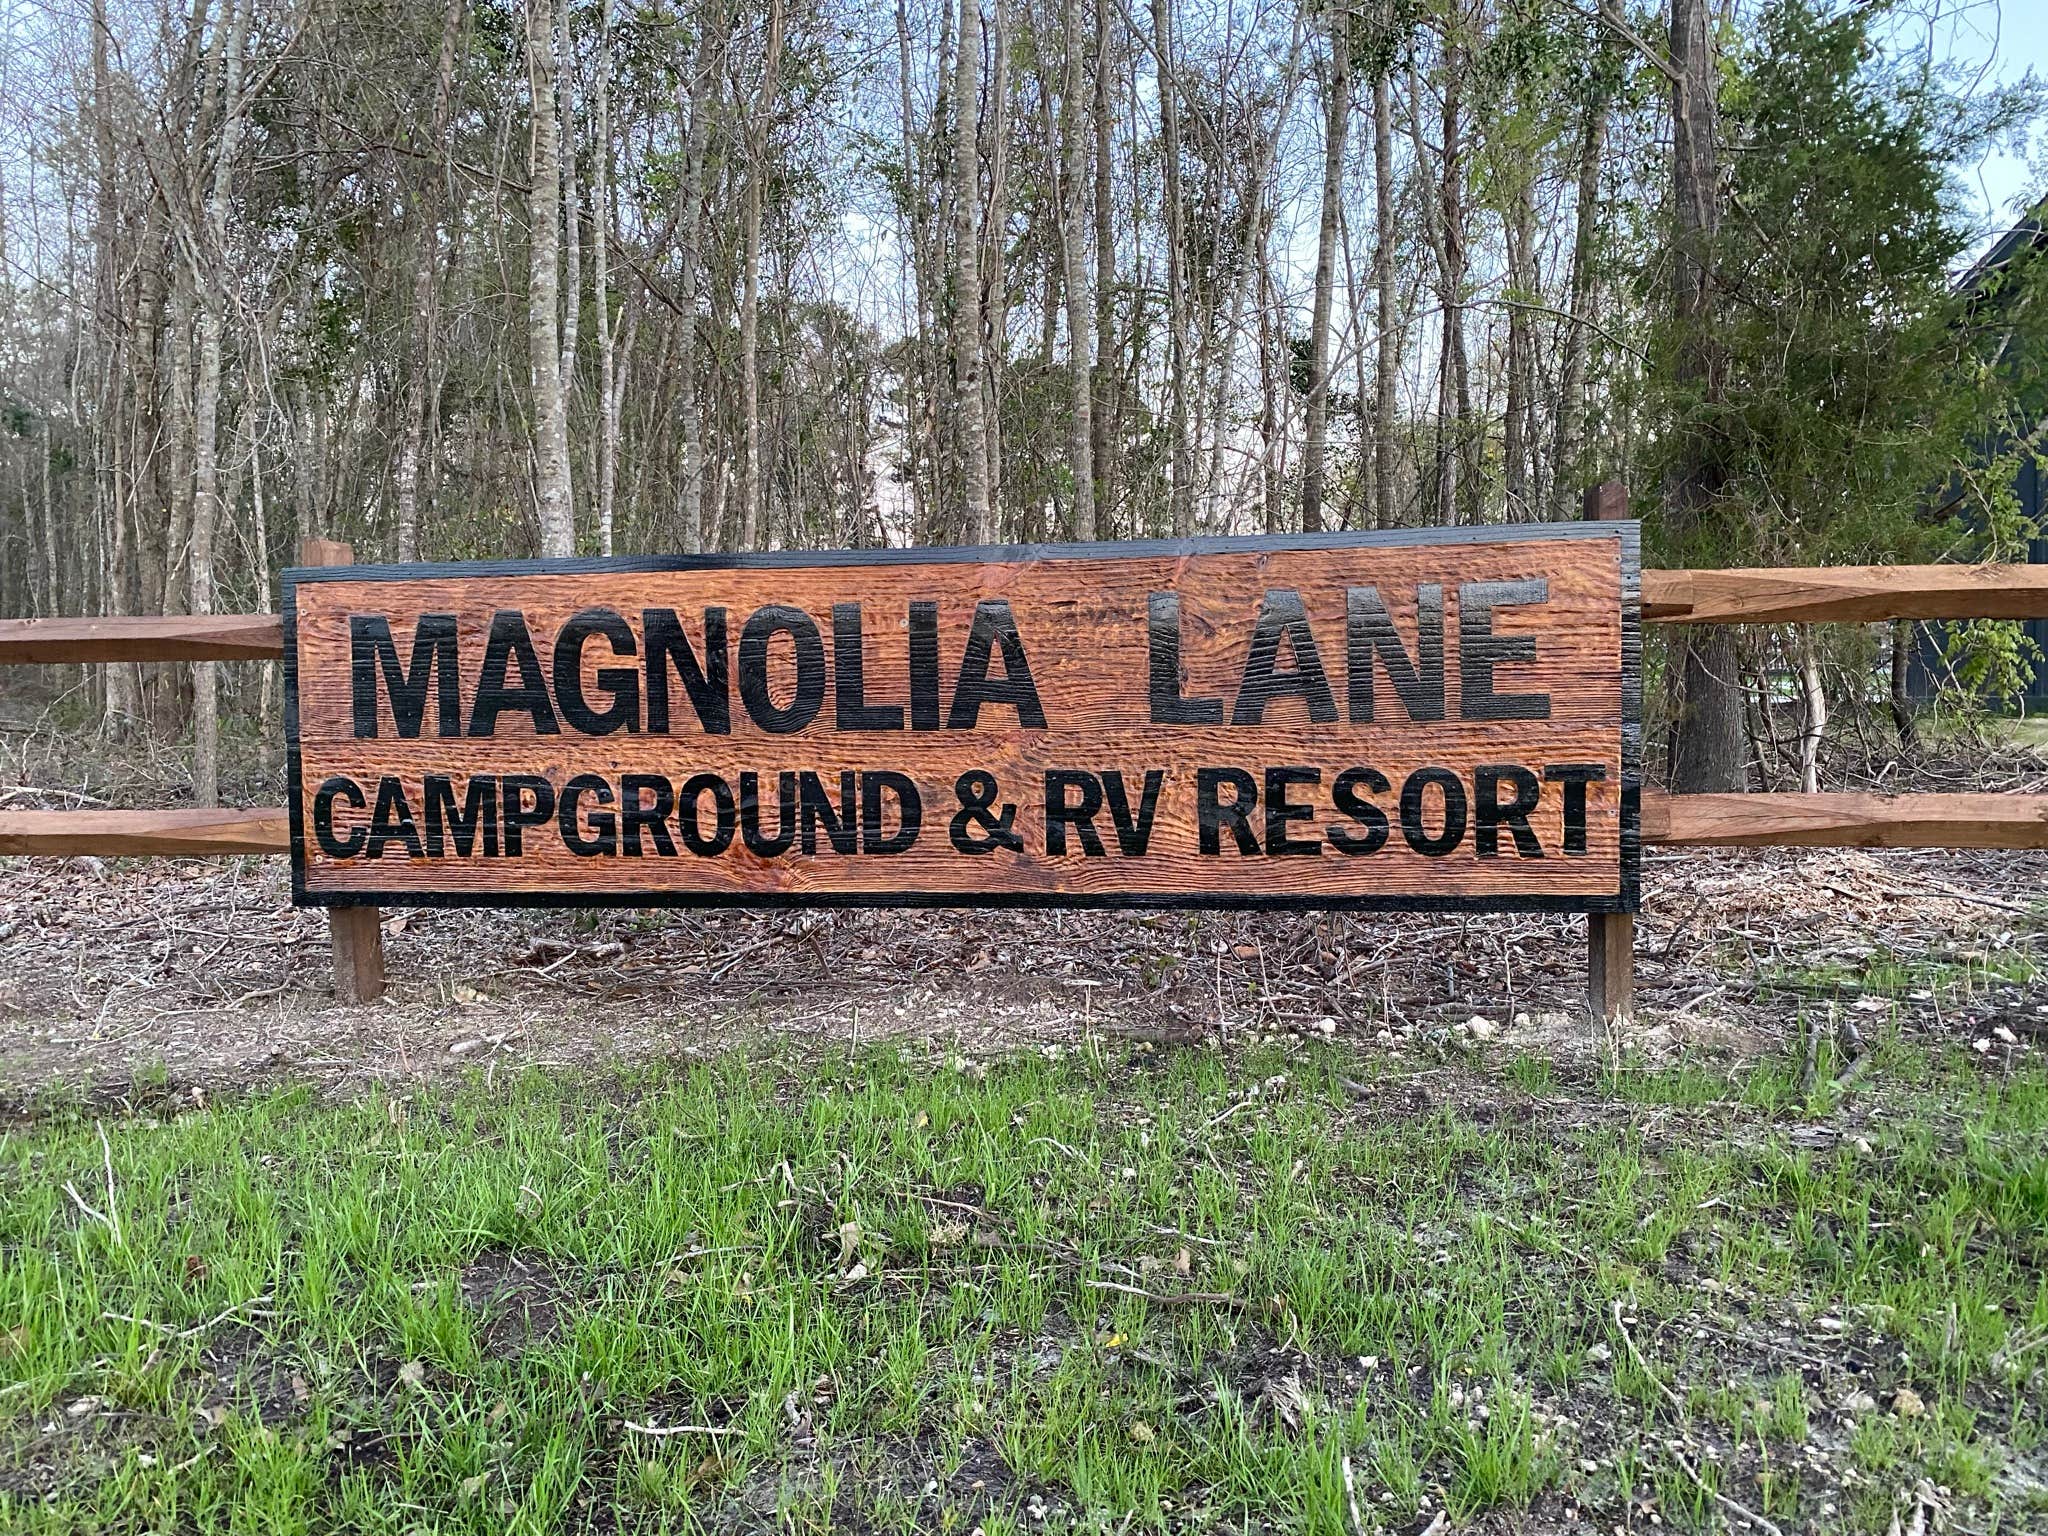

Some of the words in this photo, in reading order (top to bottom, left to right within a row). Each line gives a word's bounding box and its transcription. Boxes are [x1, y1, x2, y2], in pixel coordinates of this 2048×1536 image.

[350, 600, 1048, 738] MAGNOLIA
[1148, 578, 1551, 726] LANE
[313, 770, 922, 859] CAMPGROUND
[949, 769, 1025, 856] &
[1045, 769, 1164, 857] RV
[1198, 764, 1606, 858] RESORT
